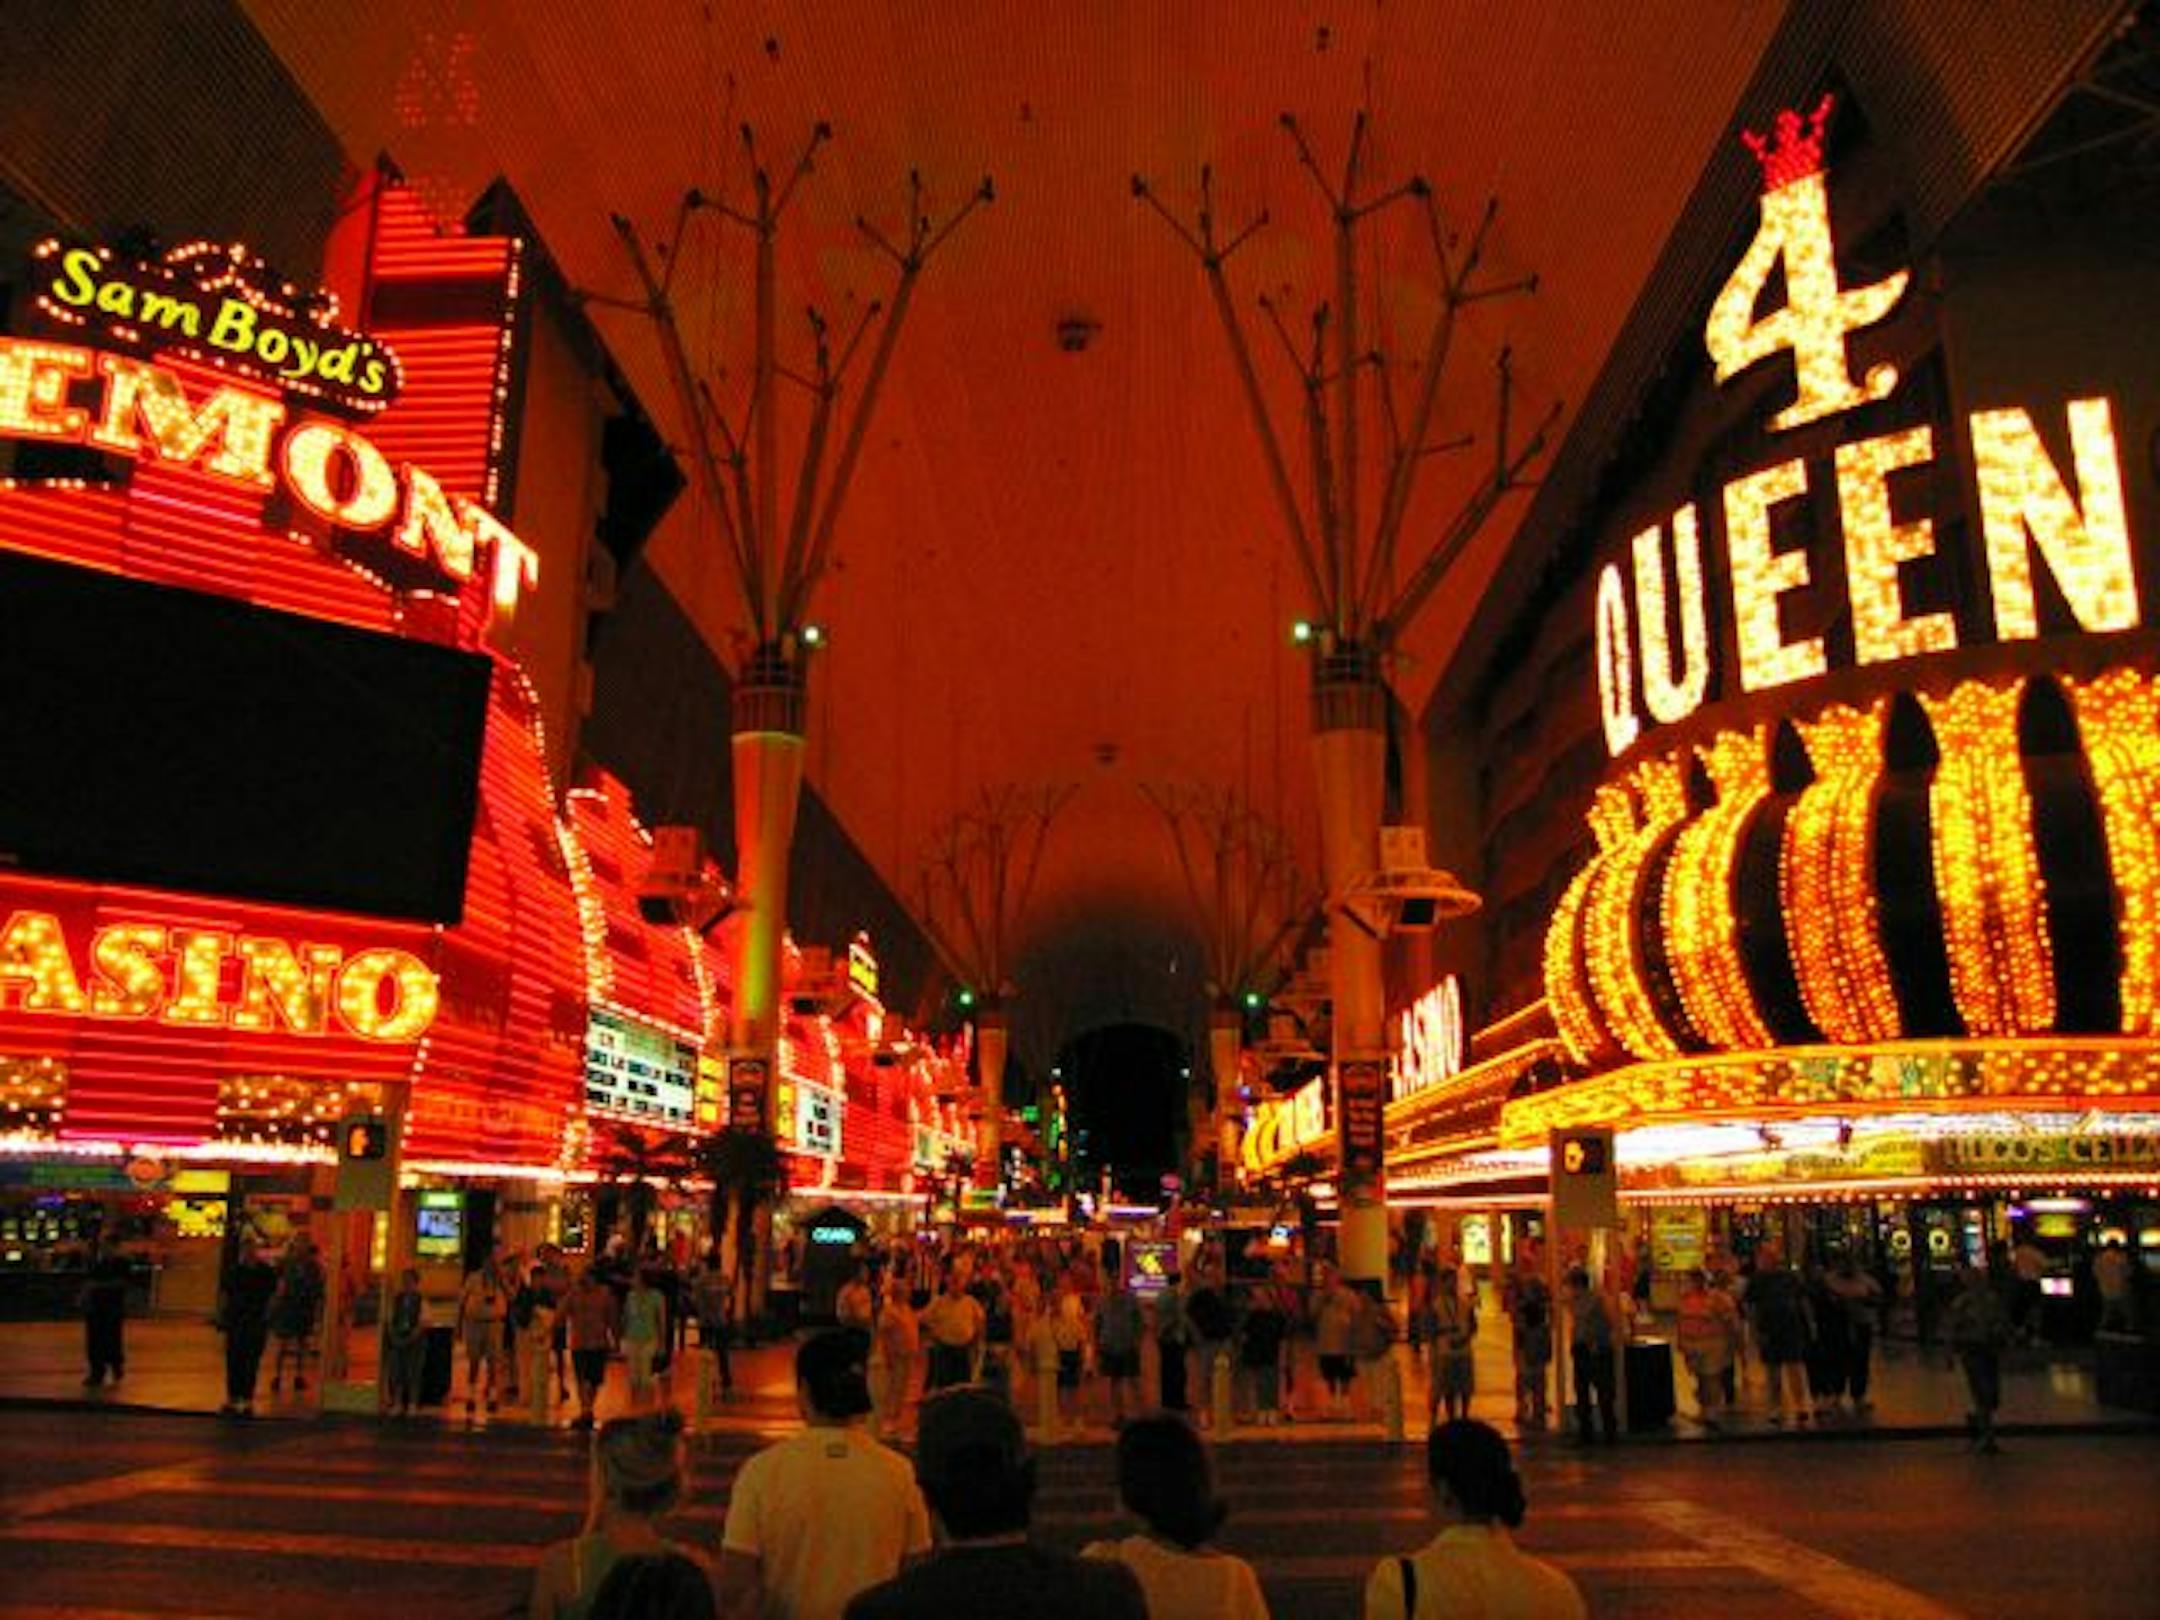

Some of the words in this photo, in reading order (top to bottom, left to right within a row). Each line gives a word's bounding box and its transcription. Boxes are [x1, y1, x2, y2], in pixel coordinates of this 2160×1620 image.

[52, 249, 200, 337] Sam
[207, 298, 388, 394] Boyd's
[1706, 172, 1909, 432] 4
[0, 338, 540, 614] EMONT
[1597, 397, 2140, 757] QUEEN
[0, 910, 441, 1043] ASINO
